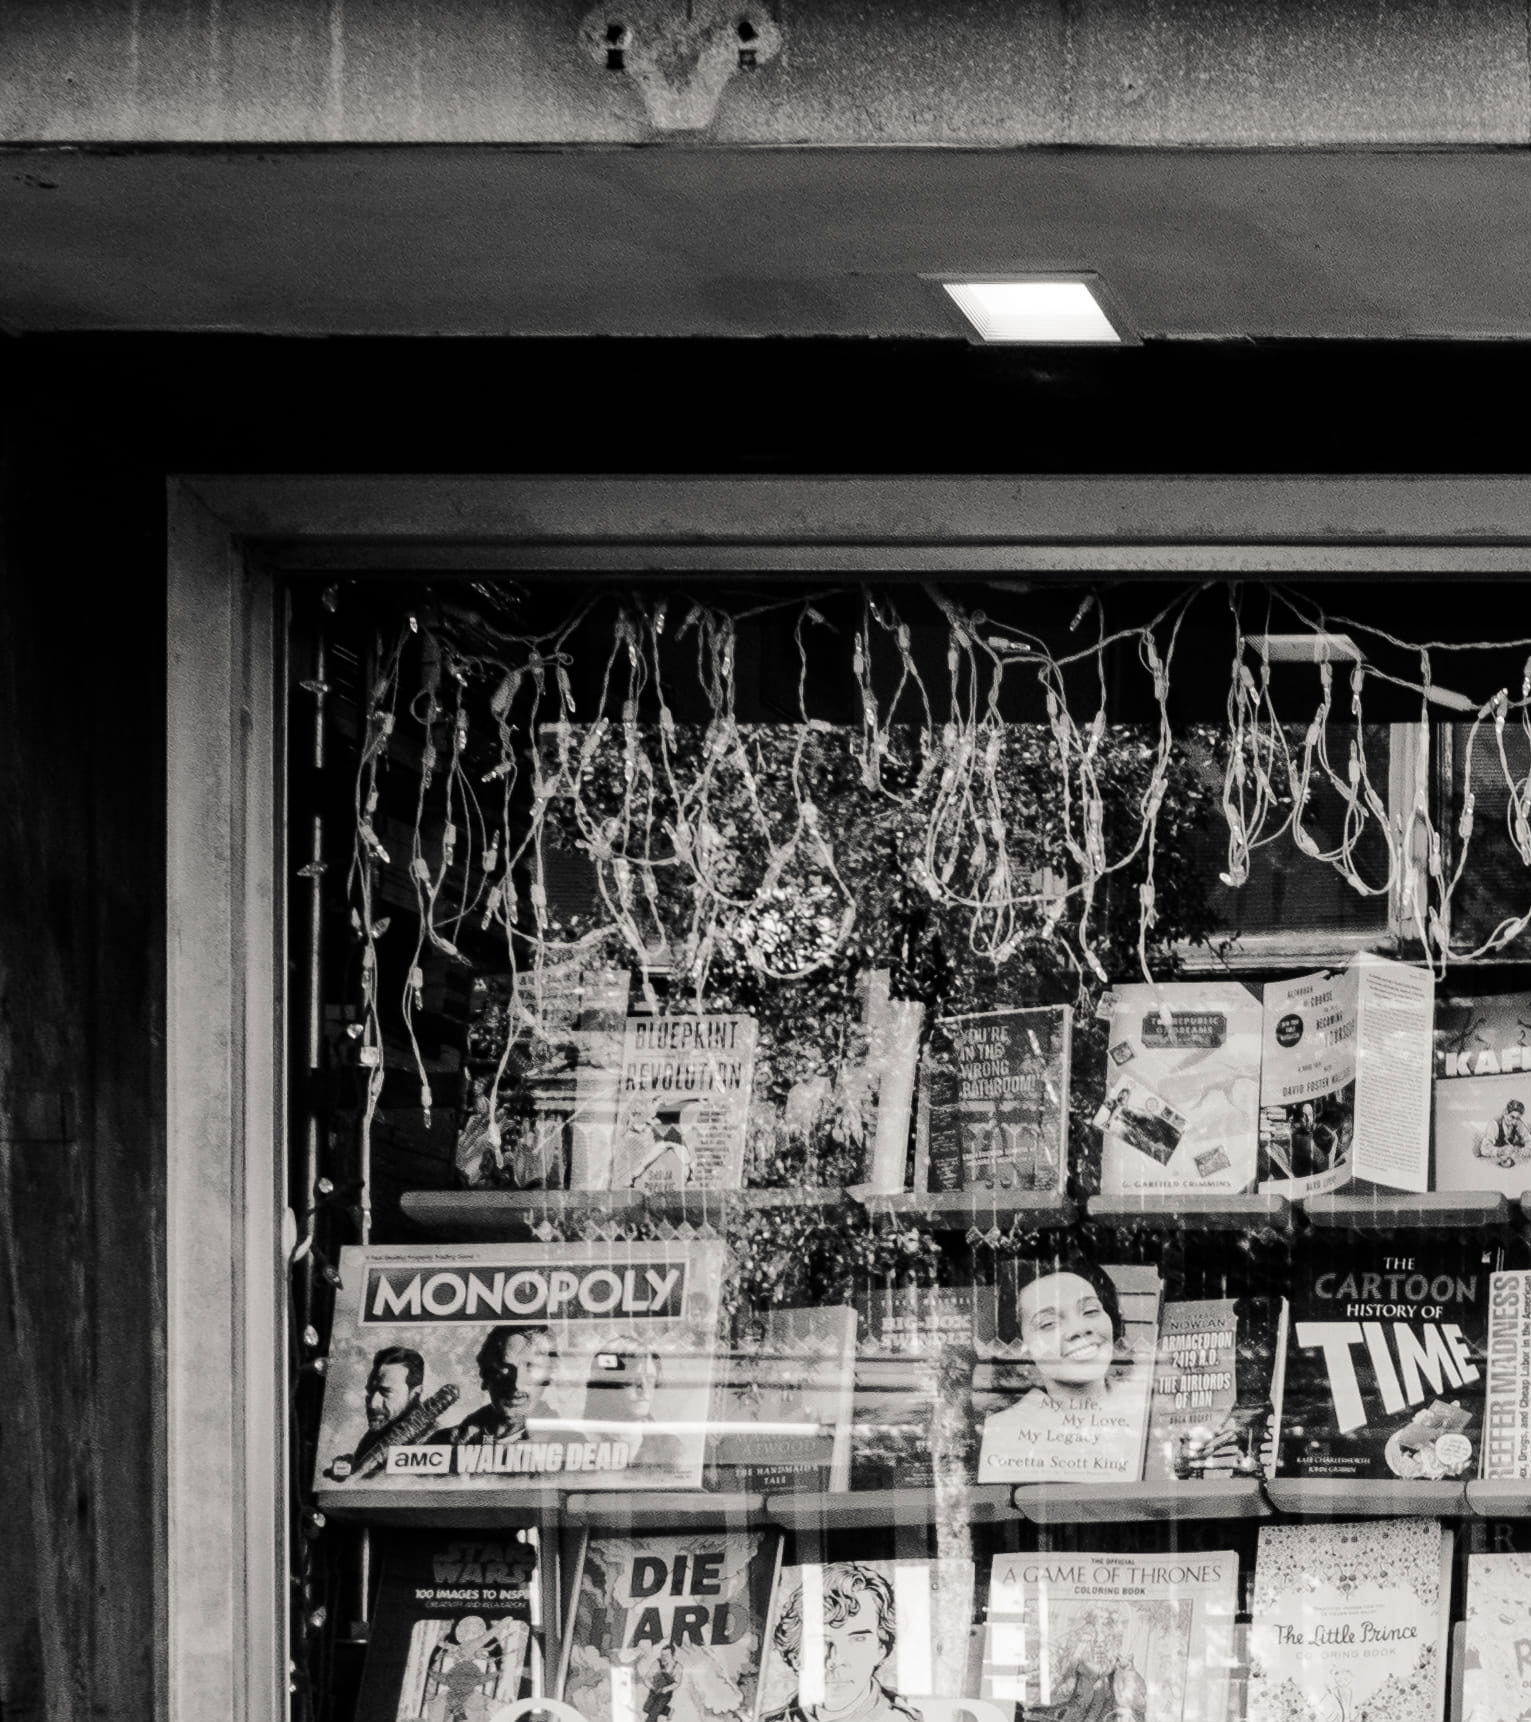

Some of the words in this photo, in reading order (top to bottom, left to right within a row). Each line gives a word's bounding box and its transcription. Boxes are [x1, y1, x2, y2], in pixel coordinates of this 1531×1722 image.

[635, 1021, 739, 1049] BLUEPRINT
[1383, 1256, 1415, 1271] THE
[372, 1268, 680, 1317] MONOPOLY
[1314, 1273, 1477, 1303] CARTOON
[1346, 1303, 1417, 1319] HISTORY
[1421, 1304, 1444, 1320] OF
[1296, 1321, 1481, 1436] TIME
[629, 1553, 725, 1598] DIE
[1002, 1566, 1017, 1584] A
[1022, 1566, 1085, 1585] GAME
[1093, 1567, 1120, 1585] OF
[1129, 1565, 1222, 1584] THRONES
[1274, 1623, 1307, 1645] The
[1308, 1622, 1355, 1646] Little
[1360, 1623, 1418, 1645] Prince
